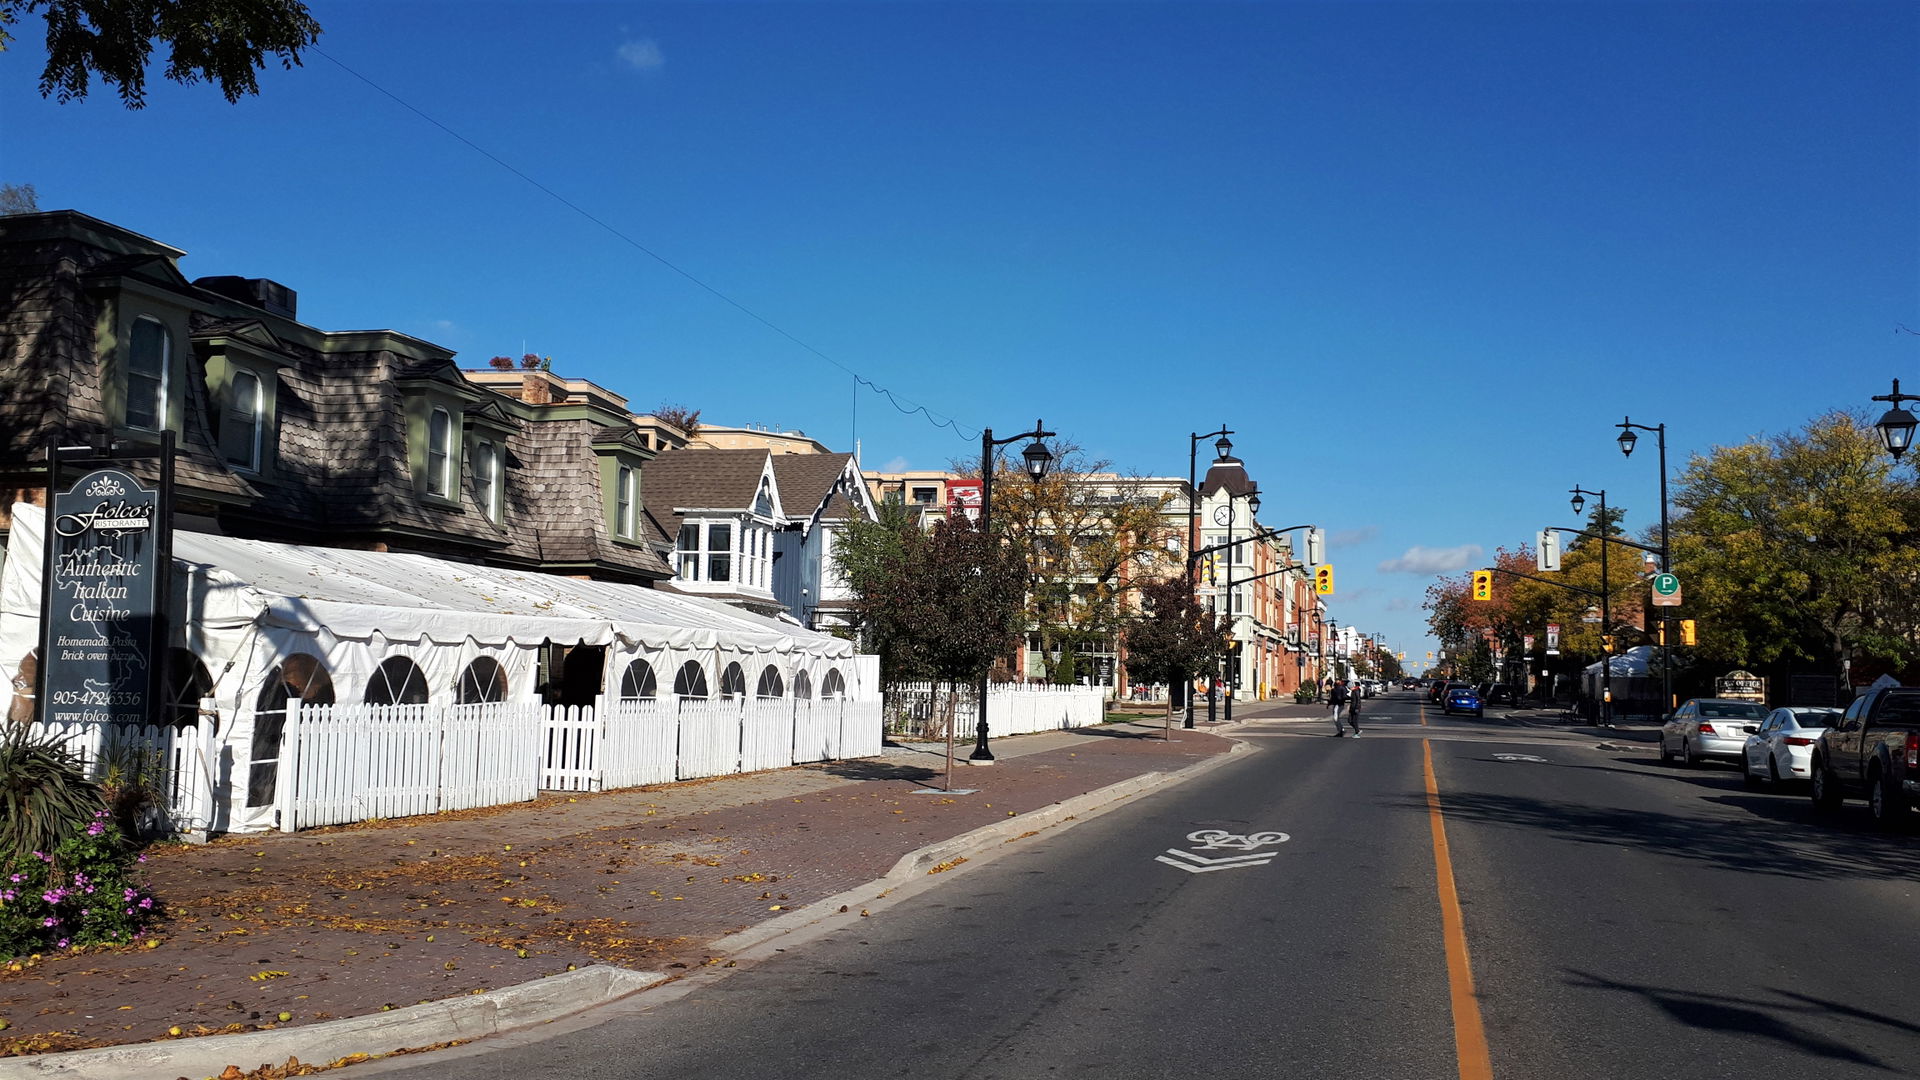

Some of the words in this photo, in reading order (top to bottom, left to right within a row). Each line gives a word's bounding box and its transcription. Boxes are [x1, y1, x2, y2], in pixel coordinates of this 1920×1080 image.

[94, 519, 148, 528] RISTORANTE
[61, 559, 142, 577] Authentic
[1662, 576, 1673, 588] P
[72, 581, 128, 599] Italian
[70, 603, 131, 622] Cuisine
[57, 635, 109, 647] Homemade
[61, 649, 84, 661] Brick
[86, 652, 108, 661] oven
[52, 690, 142, 706] 905-472-6336
[54, 708, 140, 723] www.folcos.com
